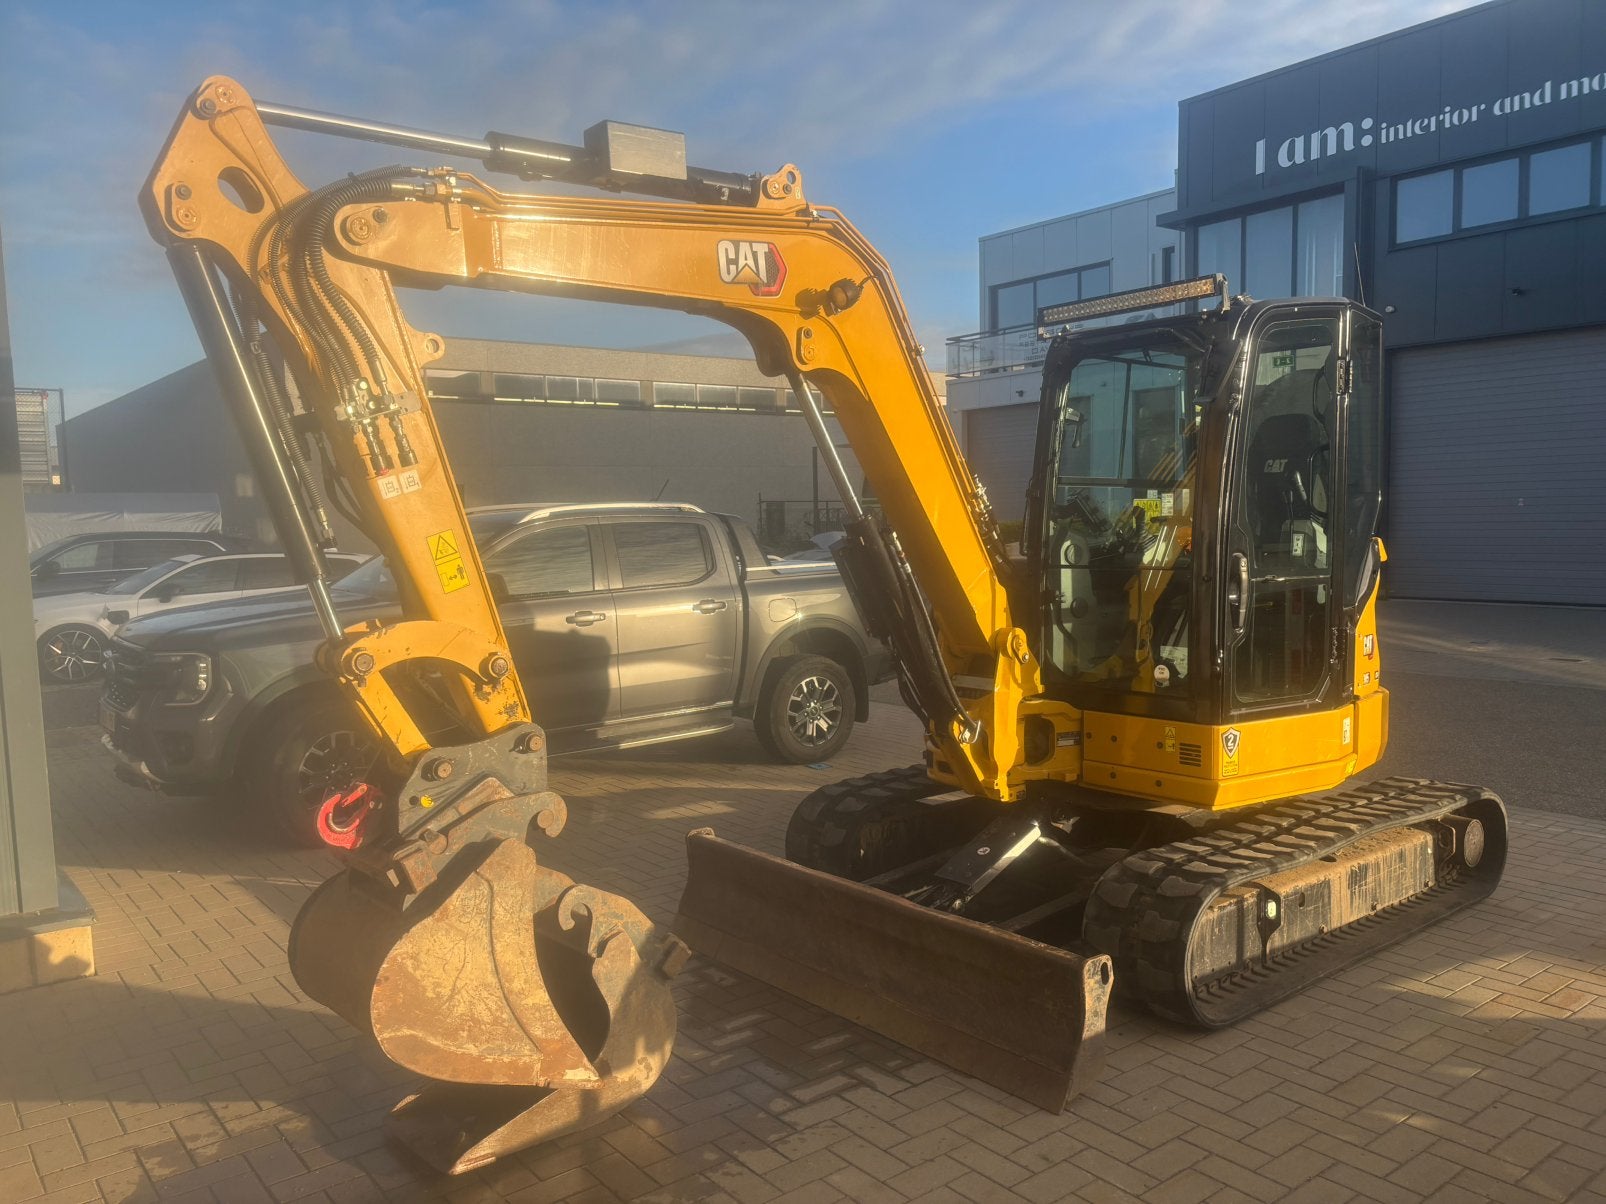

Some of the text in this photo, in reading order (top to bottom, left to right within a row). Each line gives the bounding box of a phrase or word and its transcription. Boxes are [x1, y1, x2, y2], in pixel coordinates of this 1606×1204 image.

[1255, 138, 1266, 175] I
[1277, 117, 1374, 168] am:
[1380, 103, 1486, 144] interior
[1493, 80, 1552, 116] and
[717, 240, 769, 284] CAT
[1263, 459, 1288, 473] CAT
